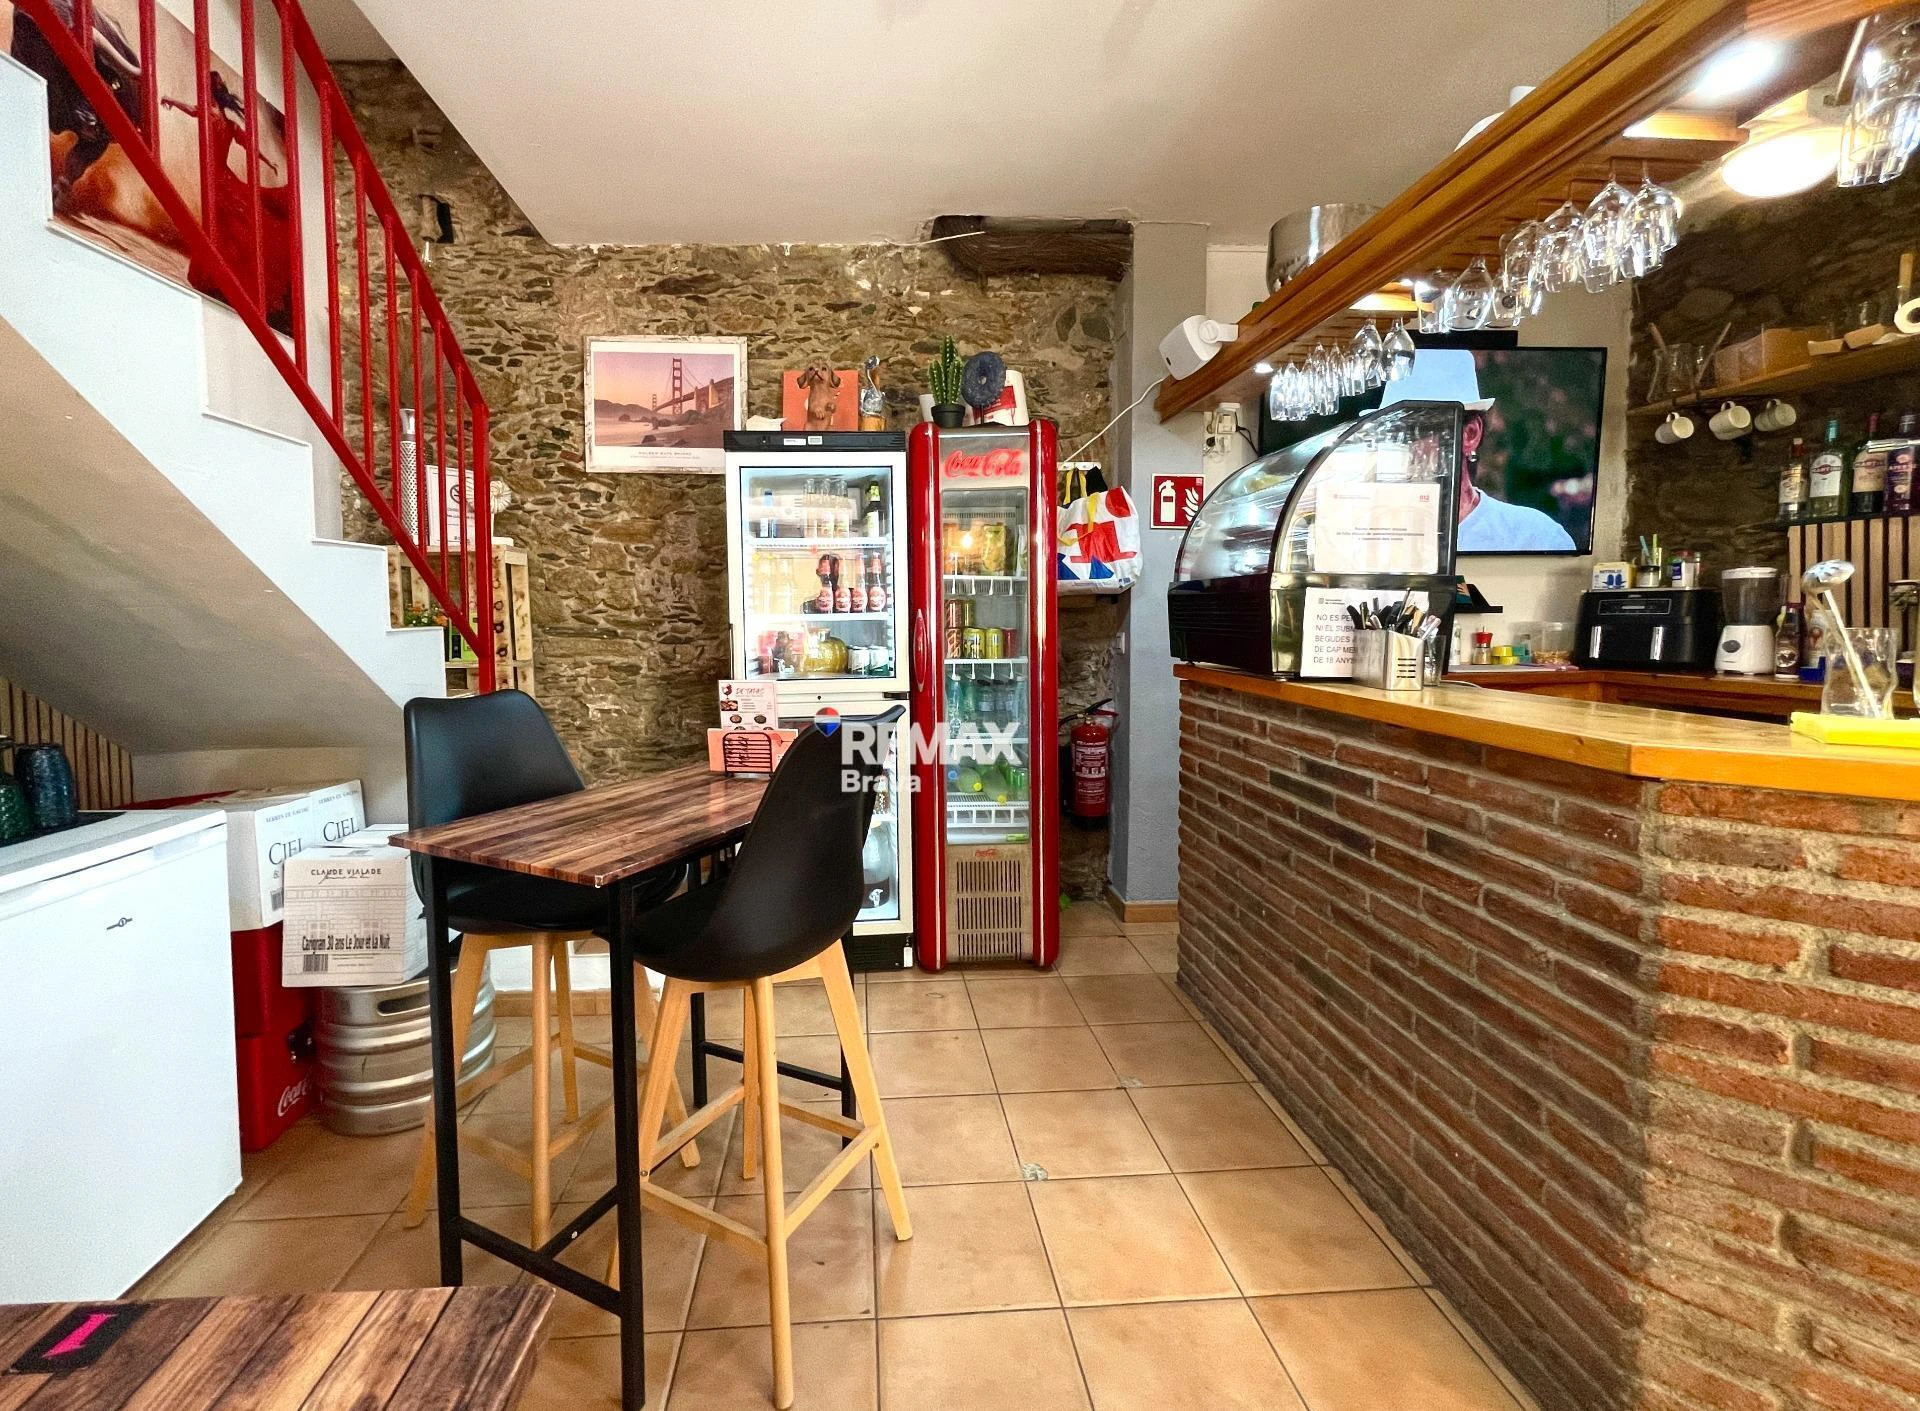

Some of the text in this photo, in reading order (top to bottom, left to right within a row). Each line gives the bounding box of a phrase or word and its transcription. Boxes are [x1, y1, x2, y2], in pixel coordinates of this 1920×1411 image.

[944, 448, 1024, 479] Coca-Cola
[323, 817, 360, 842] CIEL
[347, 868, 382, 876] VIALADE
